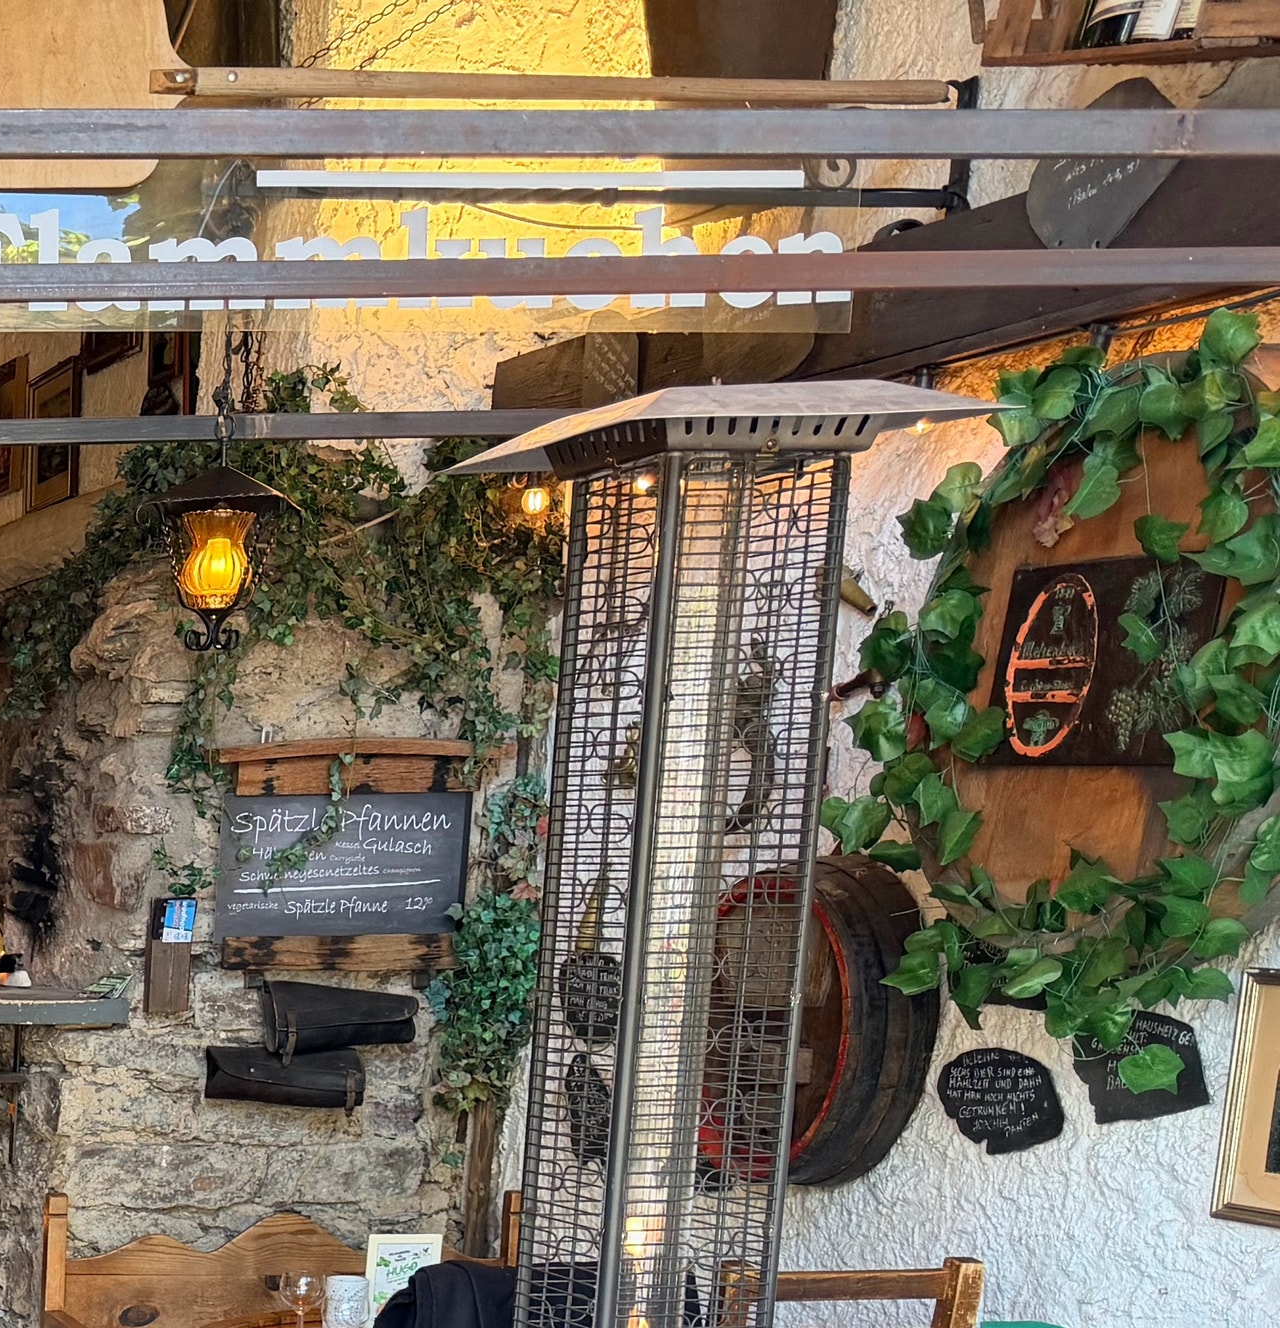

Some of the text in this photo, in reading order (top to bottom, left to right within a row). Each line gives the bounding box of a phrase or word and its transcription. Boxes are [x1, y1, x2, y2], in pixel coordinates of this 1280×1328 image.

[339, 804, 451, 841] Pfannen
[363, 837, 432, 856] Gulasch
[227, 896, 388, 920] vegetarische Spätzle Pfanne
[998, 1067, 1016, 1078] SIND
[948, 1074, 1043, 1091] MAHLZEIT UND DANN
[947, 1089, 1036, 1102] HAT MAN NOCH NICHTS
